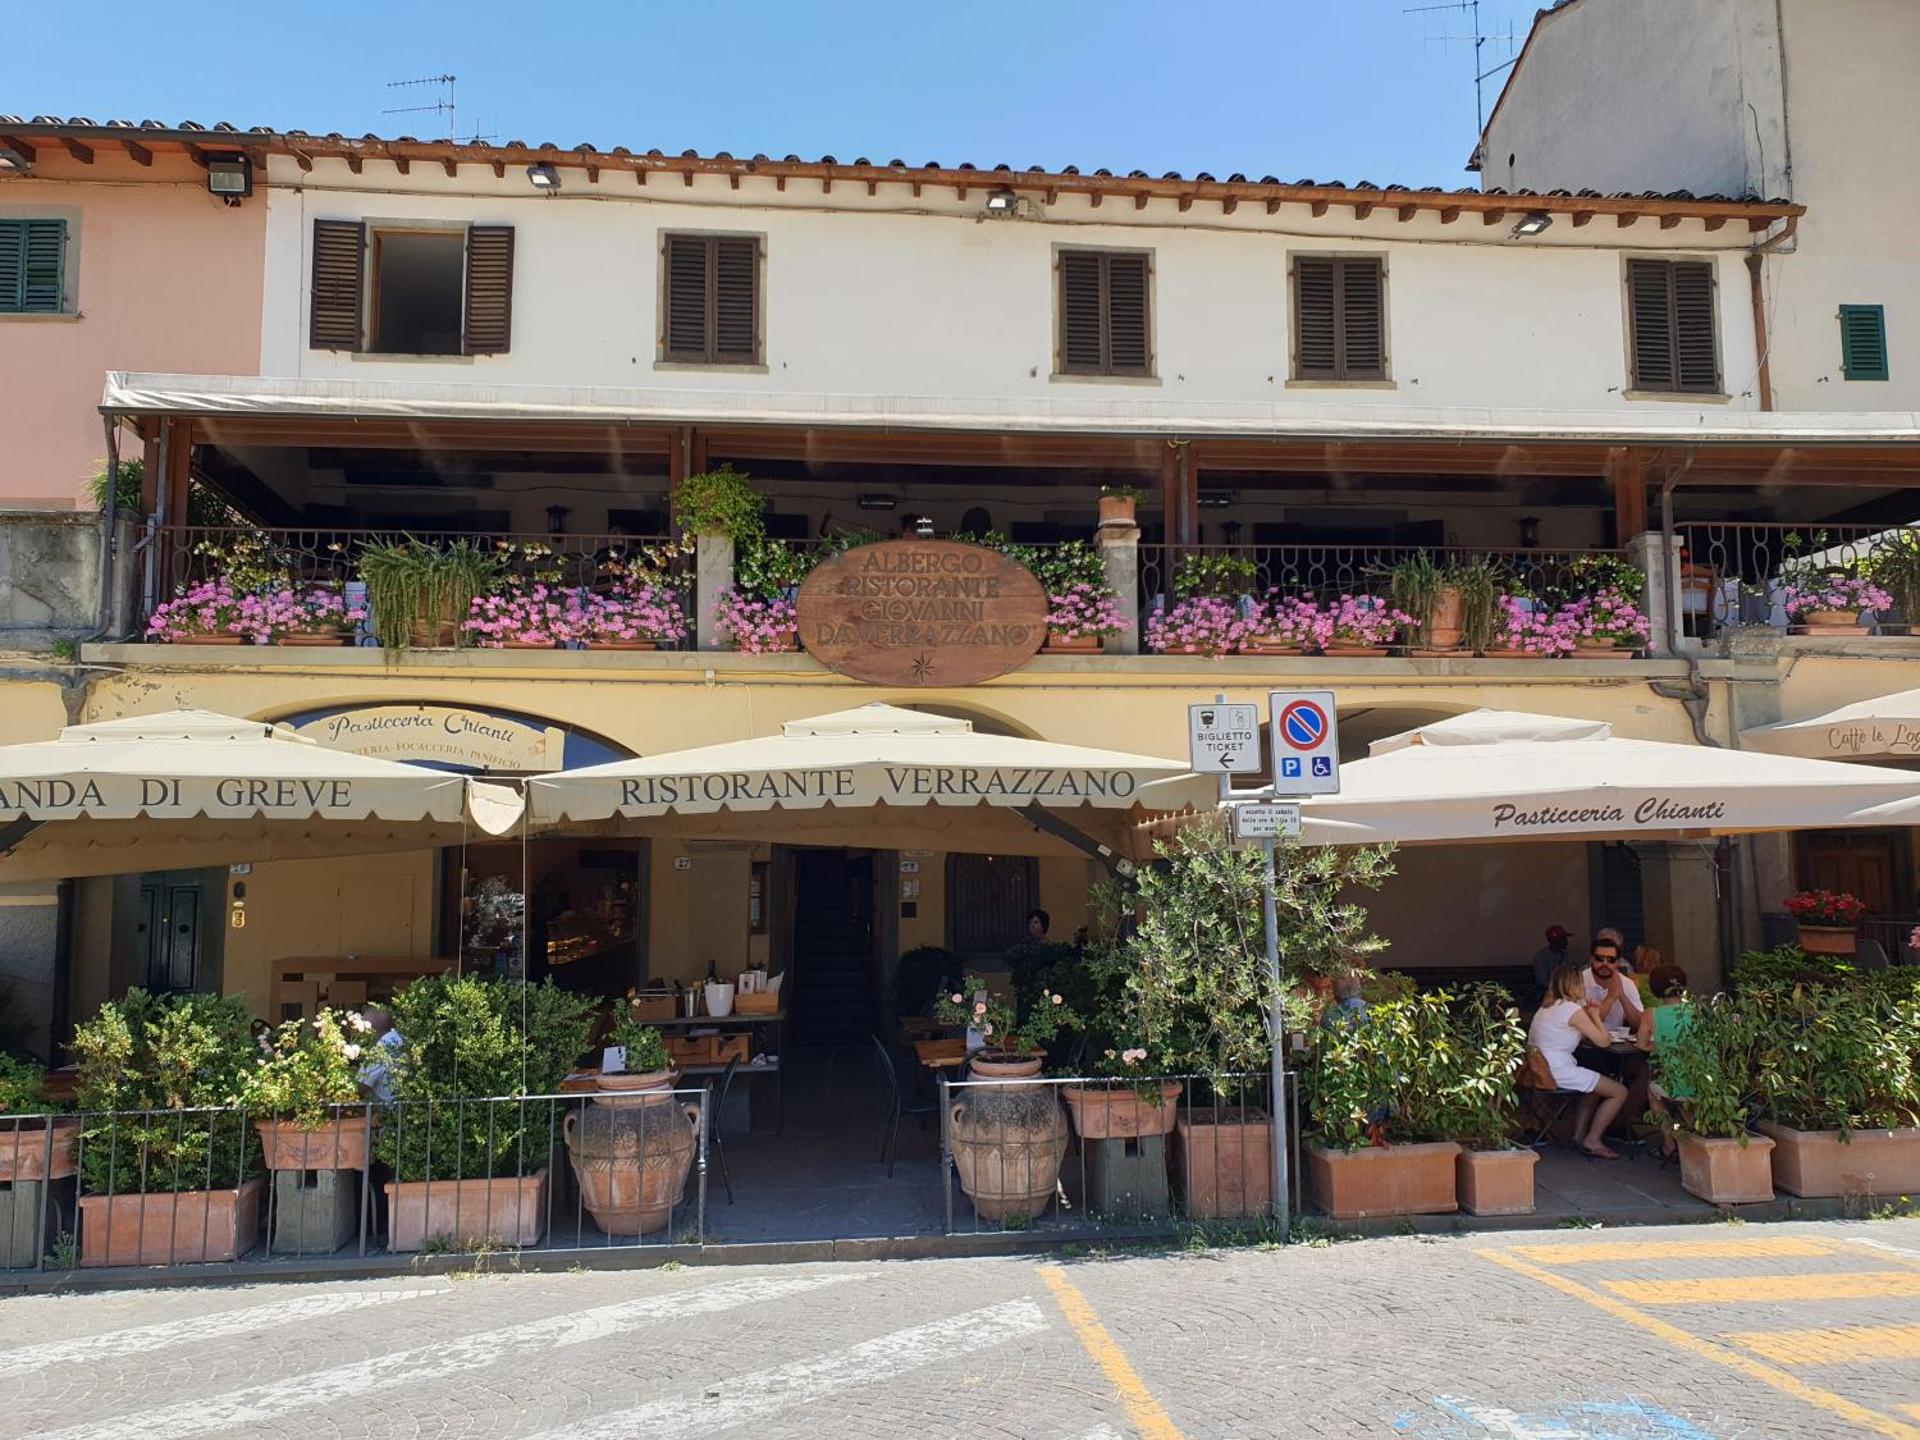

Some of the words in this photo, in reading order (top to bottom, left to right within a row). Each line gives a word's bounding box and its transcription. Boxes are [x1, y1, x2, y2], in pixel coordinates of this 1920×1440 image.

[863, 551, 982, 573] ALBERGO
[838, 576, 1000, 597] RISTORANTE
[860, 600, 985, 621] GIOVANNI
[328, 714, 434, 742] Pasticceria
[444, 712, 514, 743] Chianti
[1197, 731, 1252, 741] BIGLIETTO
[1828, 727, 1866, 752] Caffè
[1871, 725, 1884, 742] le
[396, 743, 464, 756] FOCACCERIA
[470, 750, 522, 769] PANIFICIO
[1206, 742, 1244, 751] TICKET
[1285, 760, 1298, 775] P
[138, 779, 183, 807] DI
[216, 778, 353, 808] GREVE
[620, 768, 857, 806] RISTORANTE
[884, 767, 1136, 798] VERRAZZANO
[1493, 803, 1625, 829] Pasticceria
[1634, 797, 1725, 824] Chianti
